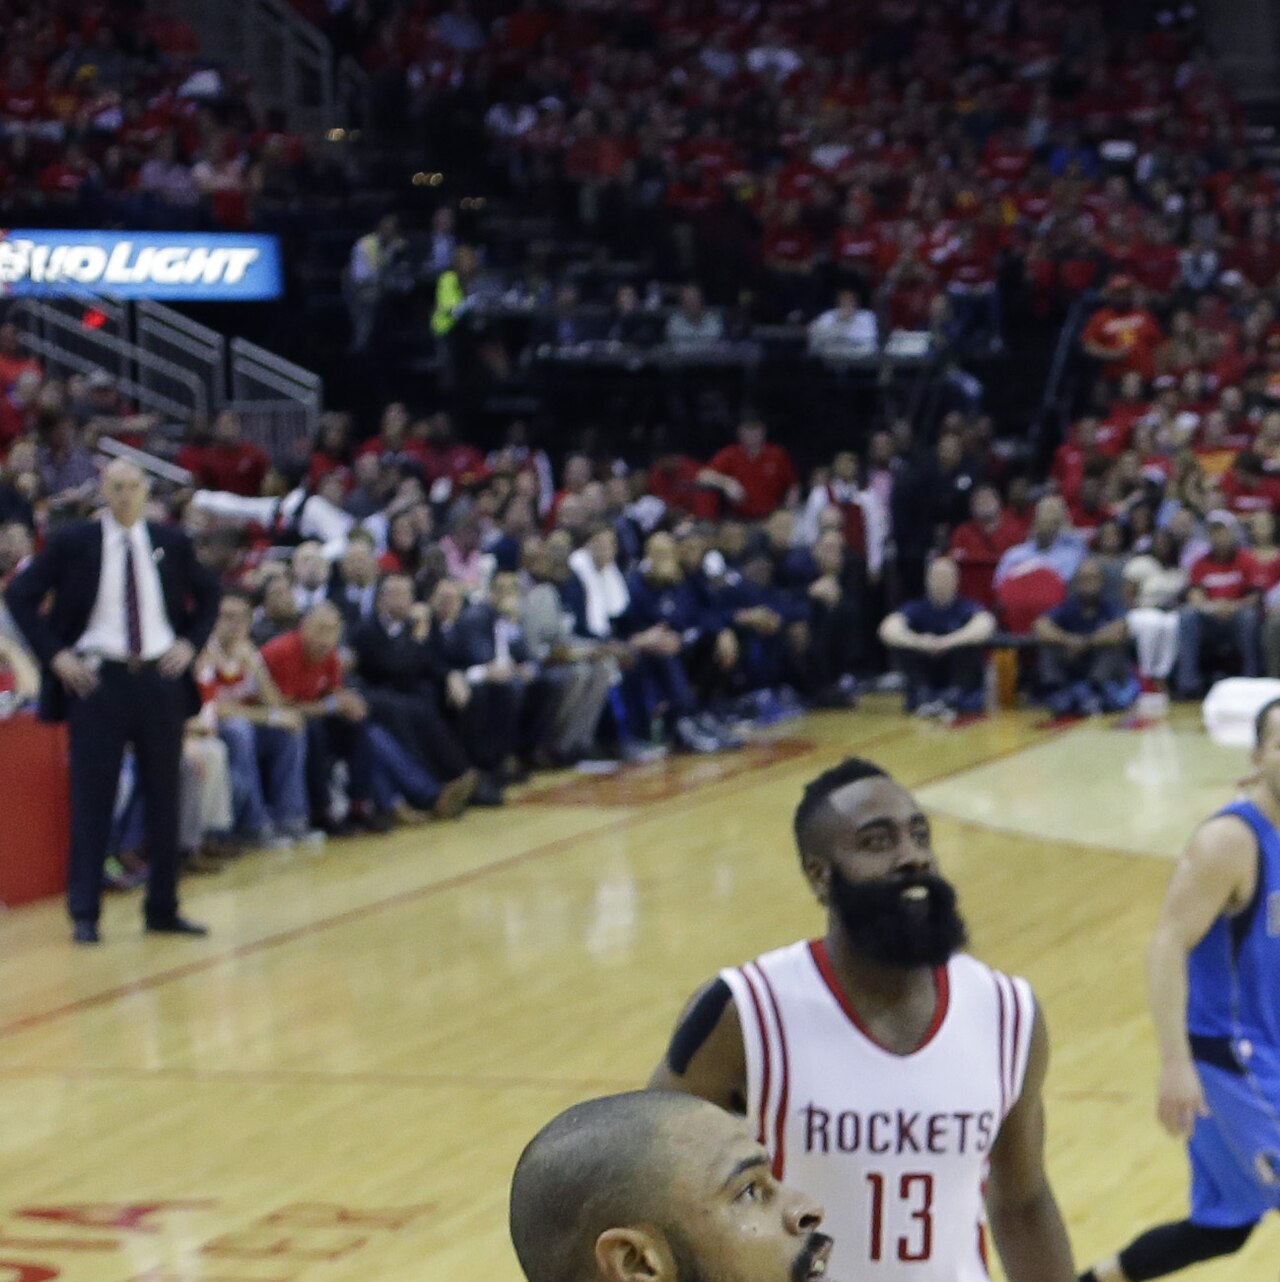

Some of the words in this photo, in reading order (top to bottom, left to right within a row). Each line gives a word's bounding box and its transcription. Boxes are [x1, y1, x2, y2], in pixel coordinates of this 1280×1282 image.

[103, 241, 259, 284] LIGHT
[799, 1101, 995, 1154] ROCKETS
[866, 1172, 933, 1262] 13
